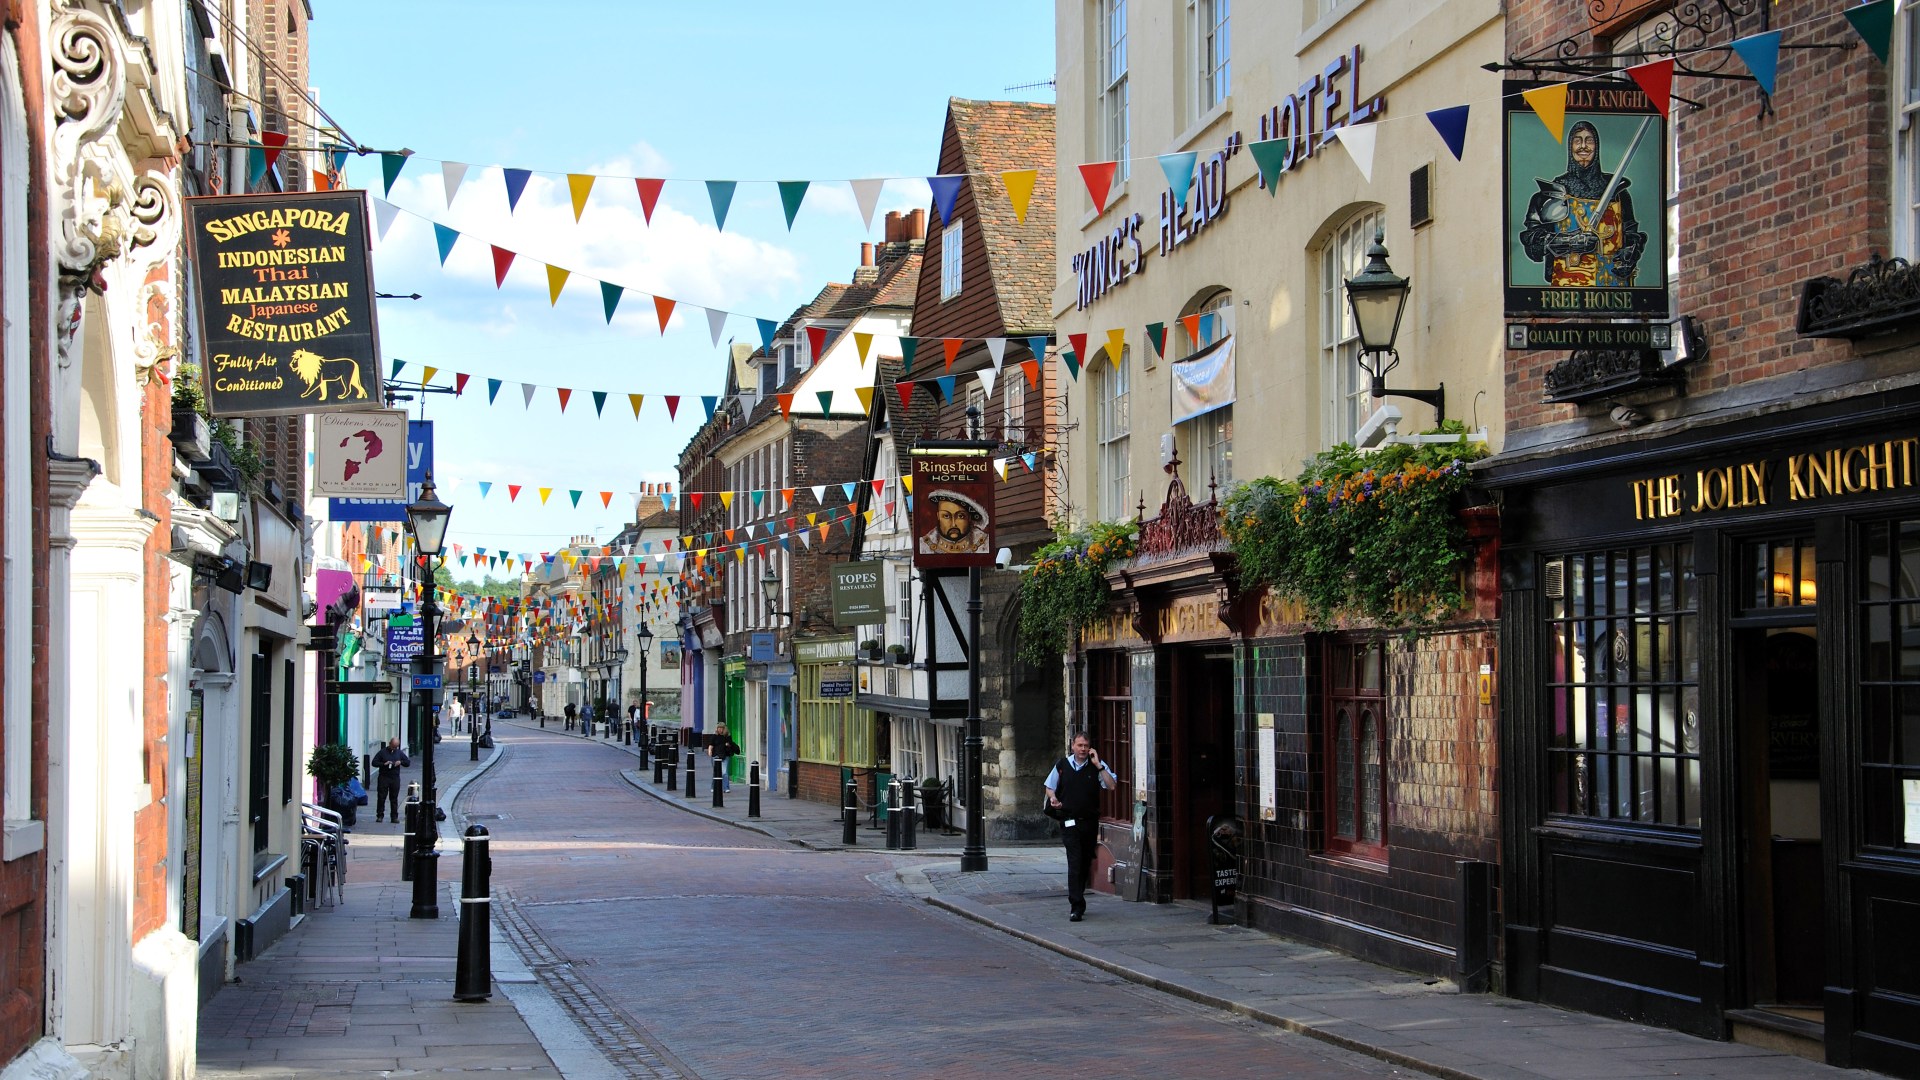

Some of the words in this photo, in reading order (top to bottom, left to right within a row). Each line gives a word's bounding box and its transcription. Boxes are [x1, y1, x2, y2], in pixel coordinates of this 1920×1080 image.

[205, 208, 350, 243] SINGAPORA
[218, 246, 346, 269] INDONESIAN
[253, 265, 310, 283] Thai
[221, 282, 349, 305] MALAYSIAN
[1540, 290, 1580, 309] FREE
[1584, 290, 1633, 309] HOUSE
[249, 301, 319, 320] Japanese
[226, 307, 351, 343] RESTAURANT
[1529, 330, 1584, 344] QUALITY
[1588, 330, 1612, 343] PUB
[1616, 329, 1649, 343] FOOD
[213, 352, 253, 372] Fully
[255, 352, 277, 370] Air
[215, 376, 283, 392] Conditioned
[323, 415, 364, 427] Dickens
[367, 416, 399, 428] House
[1628, 474, 1683, 520] THE
[1691, 459, 1769, 513] JOLLY
[1788, 437, 1919, 501] KNIGHT
[837, 572, 877, 584] TOPES
[839, 583, 876, 591] RESTAURANT
[1216, 868, 1238, 878] TASTE
